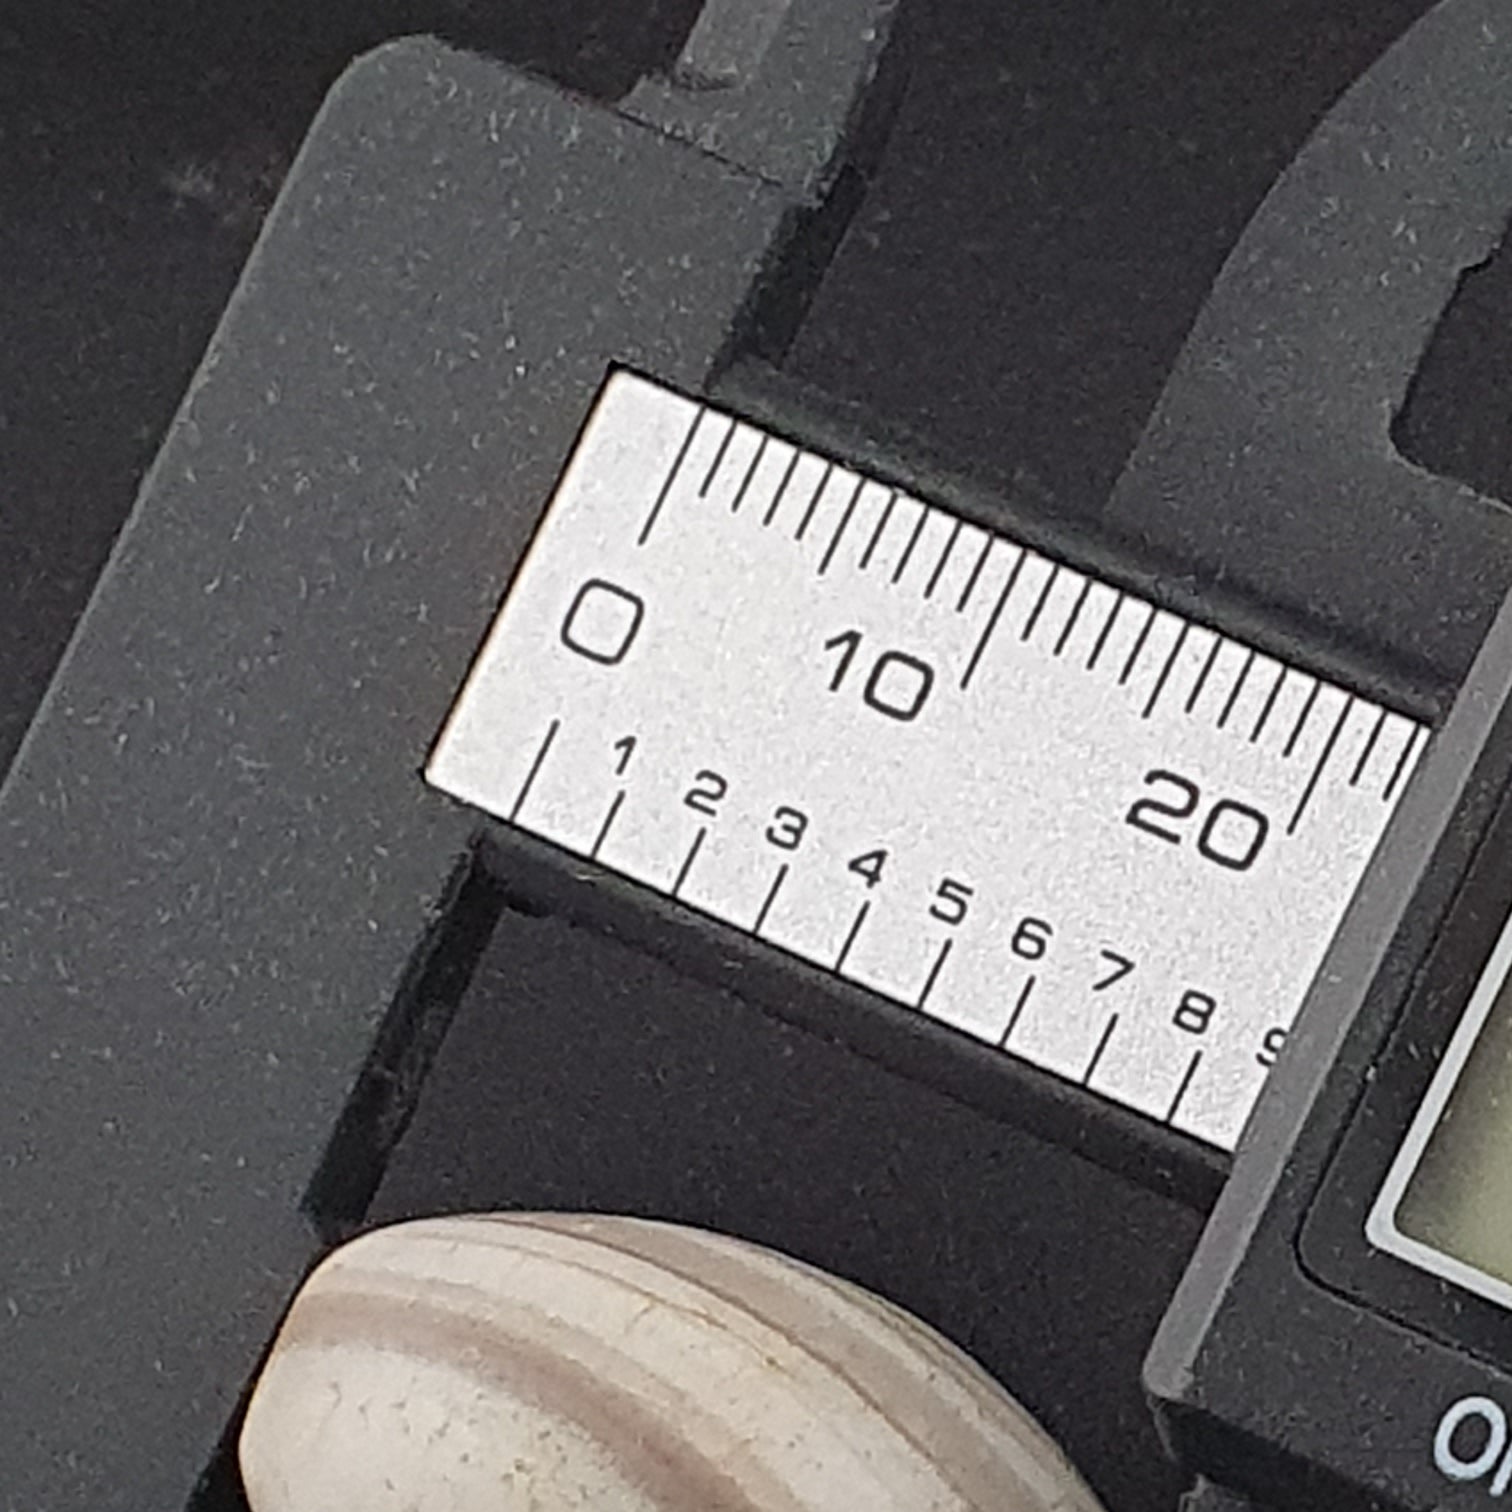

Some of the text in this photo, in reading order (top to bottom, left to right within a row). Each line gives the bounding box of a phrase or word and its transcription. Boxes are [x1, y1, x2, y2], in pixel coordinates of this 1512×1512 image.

[561, 579, 1270, 872] 0 10 20
[613, 735, 638, 774] 1
[684, 771, 727, 814] 2
[765, 807, 809, 849] 3
[847, 849, 890, 889] 4
[928, 878, 973, 924] 5
[1010, 917, 1053, 960] 6
[1092, 949, 1135, 991] 7
[1172, 990, 1216, 1034] 8
